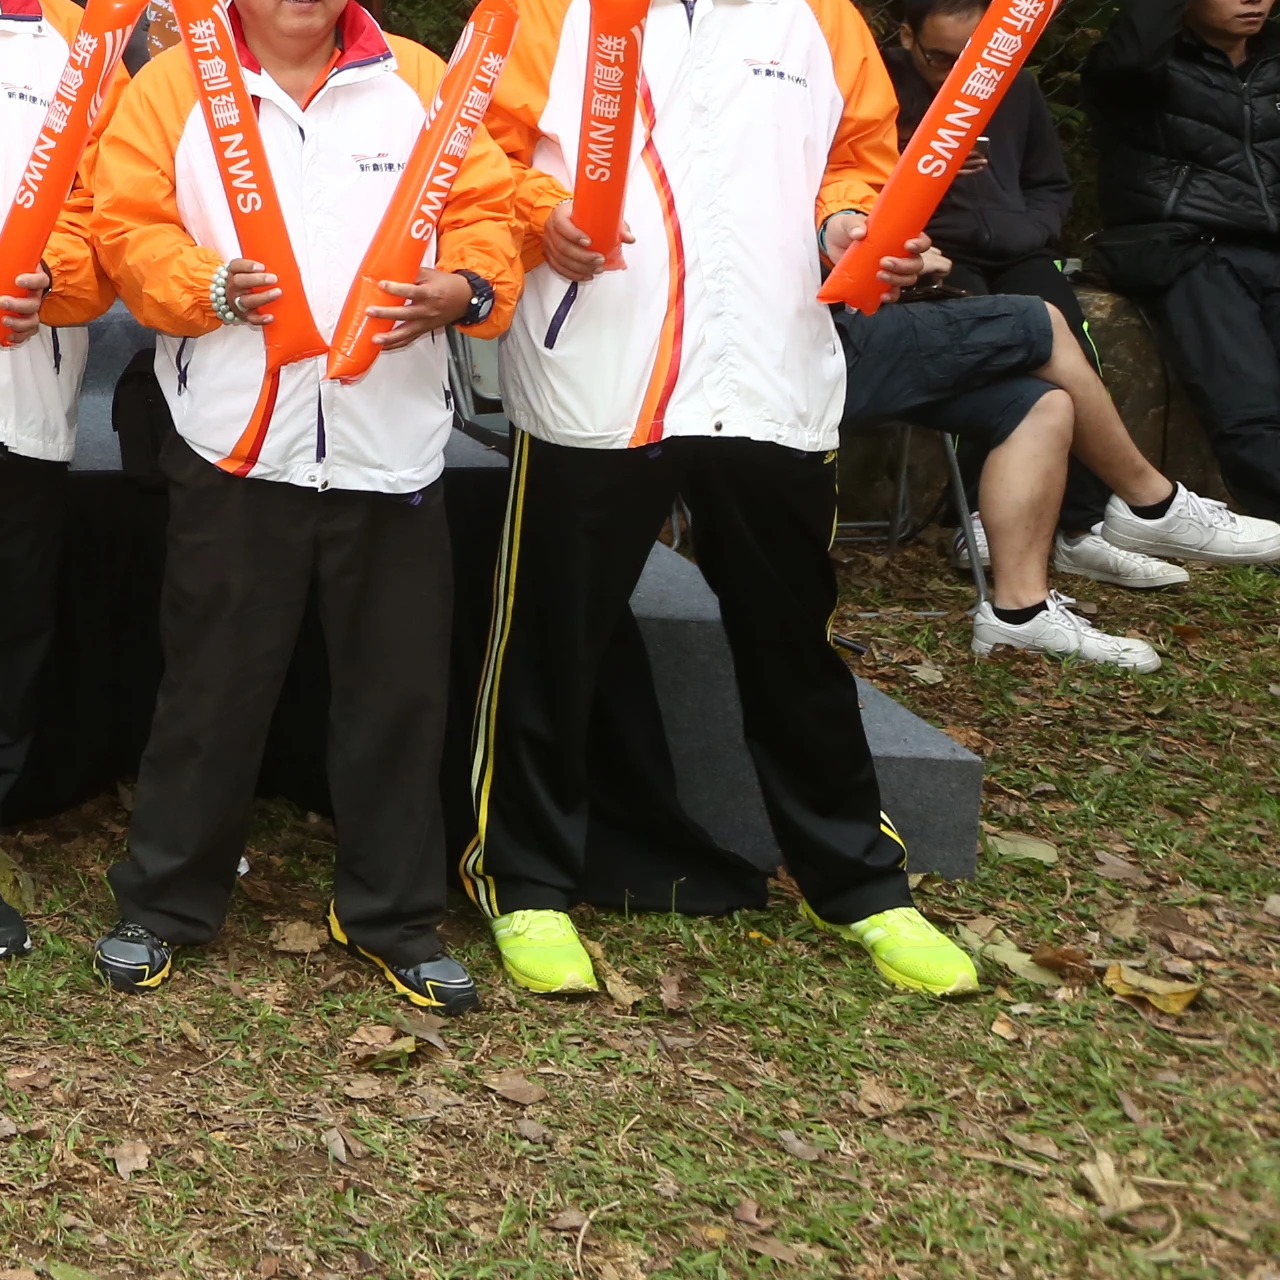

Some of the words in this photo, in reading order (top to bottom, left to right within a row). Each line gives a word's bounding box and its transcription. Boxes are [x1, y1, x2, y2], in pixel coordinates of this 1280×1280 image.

[37, 27, 99, 136] 新創建
[188, 17, 241, 129] 新創建
[218, 132, 263, 215] NWS
[444, 51, 506, 157] 新創建
[590, 33, 628, 120] 新創建
[787, 74, 808, 88] NWS
[14, 132, 59, 210] NWS
[584, 121, 618, 183] NWS
[916, 98, 981, 179] NWS
[410, 160, 459, 242] NWS
